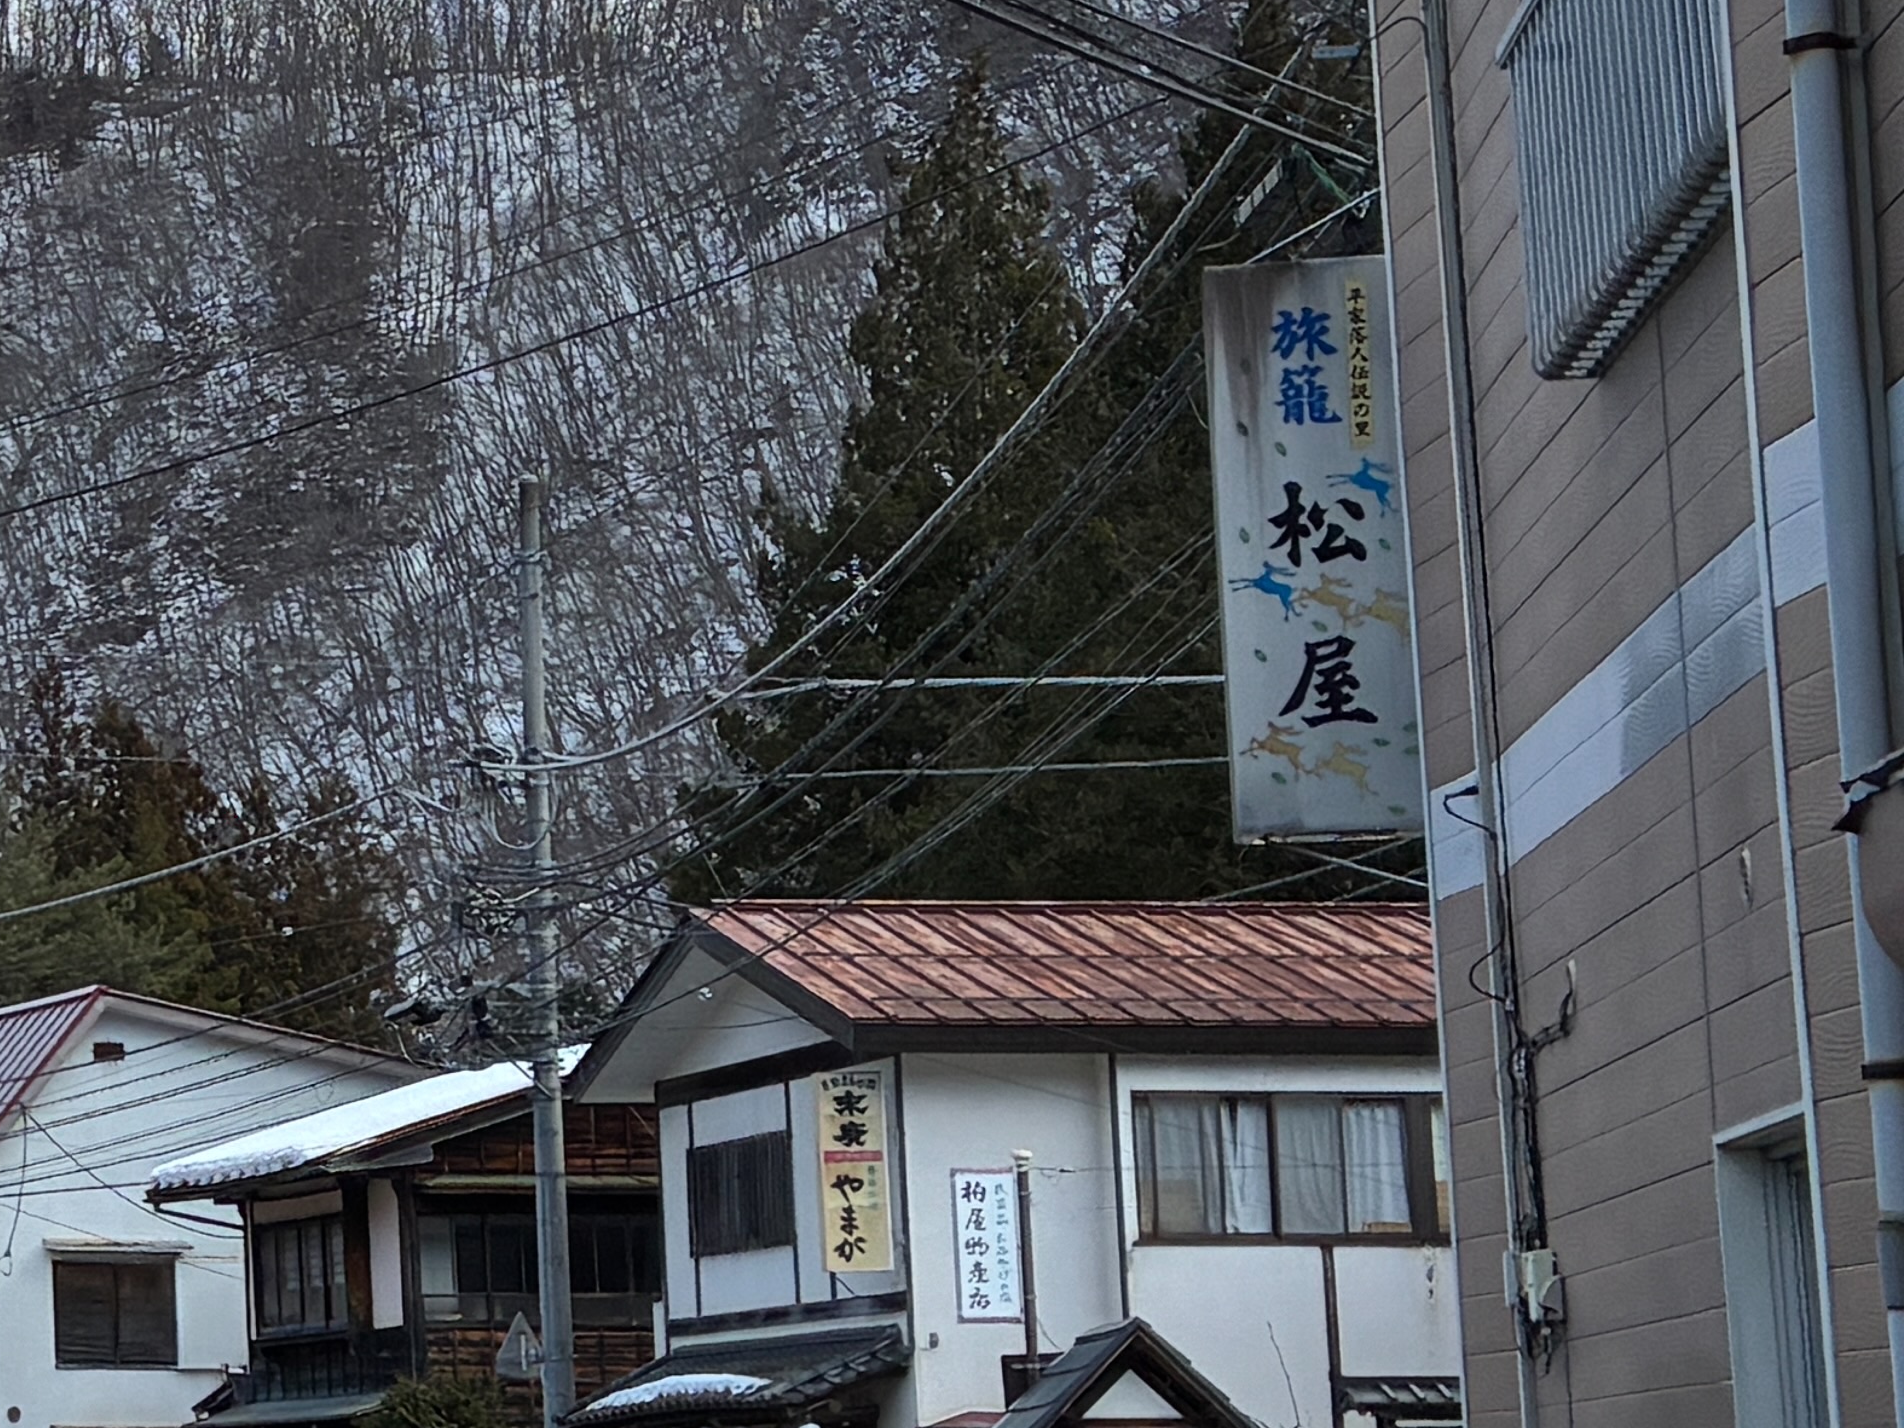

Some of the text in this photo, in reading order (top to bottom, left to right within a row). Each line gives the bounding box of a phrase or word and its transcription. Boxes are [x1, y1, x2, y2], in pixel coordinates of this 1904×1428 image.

[1270, 305, 1343, 426] 旅籠
[1267, 480, 1378, 728] 松屋
[831, 1174, 868, 1263] やまが
